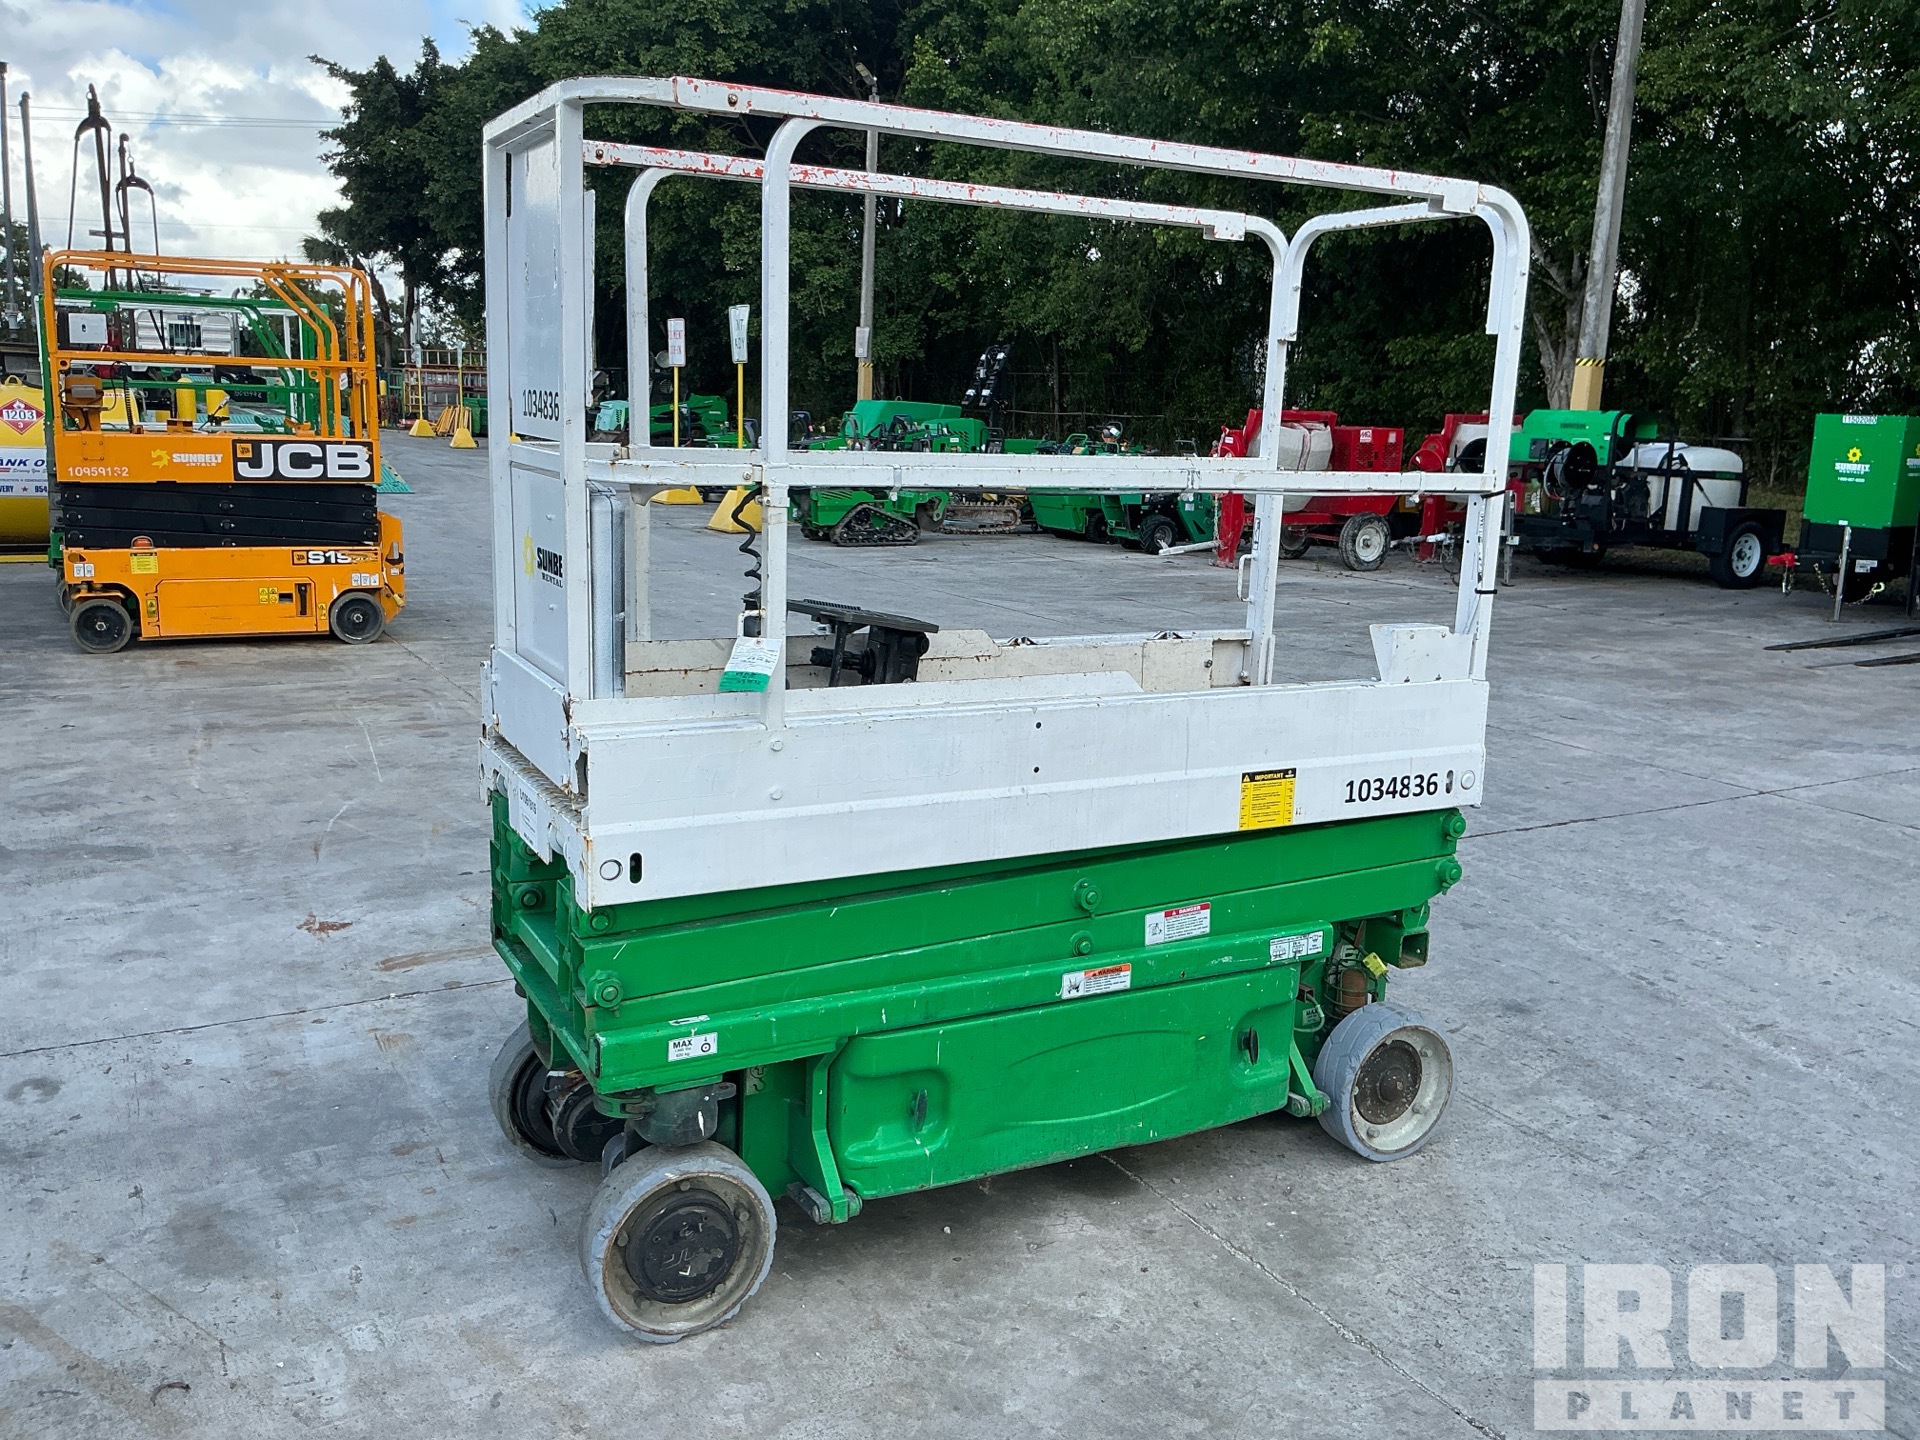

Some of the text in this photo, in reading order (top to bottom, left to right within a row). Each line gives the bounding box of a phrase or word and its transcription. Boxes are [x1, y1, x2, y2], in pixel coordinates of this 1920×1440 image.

[522, 389, 560, 422] 1034836
[6, 409, 35, 420] 1203
[172, 453, 223, 463] SUNBELT
[237, 443, 371, 478] JCB
[1255, 772, 1284, 781] IMPORTANT
[1344, 772, 1438, 803] 1034836
[1179, 905, 1201, 914] DANGER
[1098, 966, 1123, 976] WARNING
[673, 1039, 693, 1049] MAX
